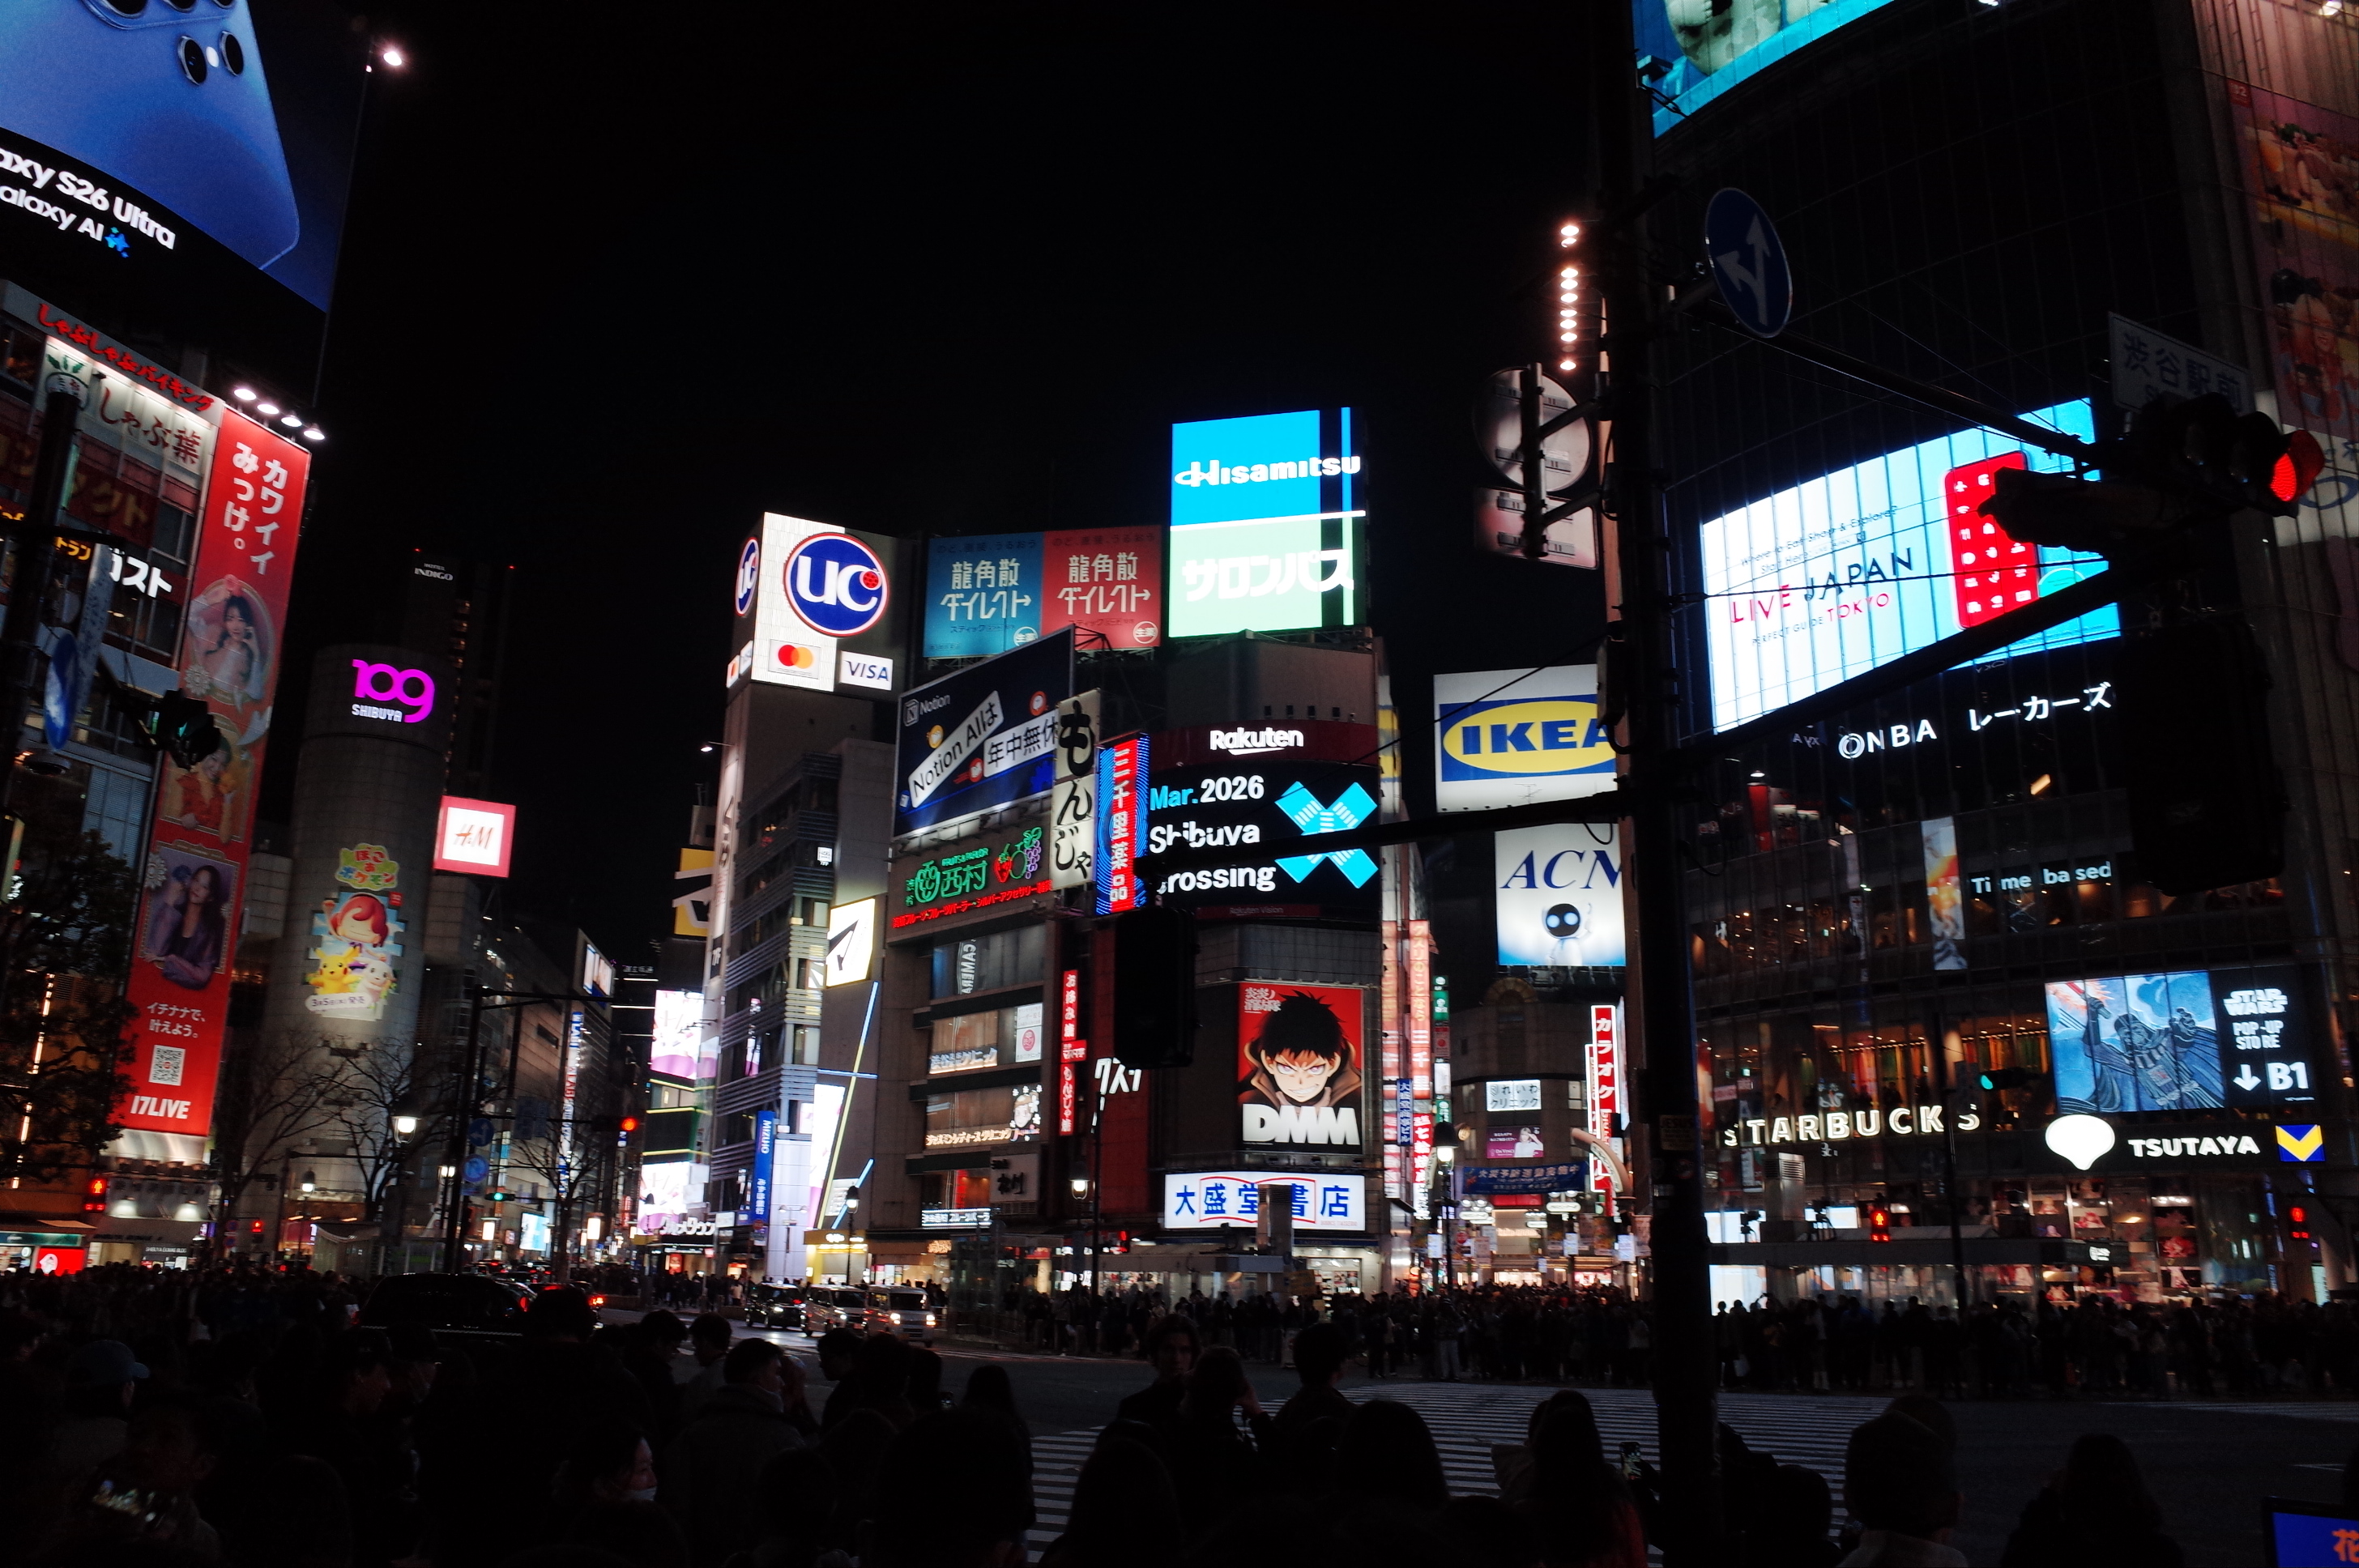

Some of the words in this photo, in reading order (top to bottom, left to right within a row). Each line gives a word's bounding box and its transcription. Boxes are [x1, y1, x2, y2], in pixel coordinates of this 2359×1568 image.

[55, 171, 110, 211] S26
[113, 196, 176, 250] Ultra
[77, 217, 105, 241] AI
[38, 303, 215, 411] しゃぶしゃぶバイキング
[99, 387, 203, 465] しゃぶ葉
[1175, 456, 1361, 487] Hisamitsu
[223, 441, 260, 550] みつけ。
[250, 458, 288, 576] カワイイ
[414, 568, 454, 582] INDIGO
[951, 557, 1021, 590] 龍角散
[1069, 552, 1138, 583] 龍角散
[1182, 548, 1354, 602] サロンパス
[1057, 584, 1151, 616] ダイレクト
[1730, 584, 1791, 624] LIVE
[1804, 548, 1913, 601] JAPAN
[940, 590, 1032, 621] ダイレクト
[1752, 627, 1790, 646] PERFECT
[1794, 617, 1824, 633] GUIDE
[1827, 593, 1889, 622] TOKYO
[844, 660, 889, 682] VISA
[352, 659, 435, 723] 109
[919, 693, 951, 715] Notion
[1969, 681, 2112, 731] レーカーズ
[352, 704, 403, 722] SHIBUYA
[1209, 726, 1304, 752] Rakuten
[1461, 718, 1610, 755] IKEA
[913, 739, 962, 798] Notion
[1054, 699, 1095, 879] もんじゃ
[454, 823, 495, 850] H&M
[1109, 748, 1131, 901] 三千里薬品
[339, 866, 396, 886] ポケモン
[1157, 866, 1277, 894] rossing
[2043, 861, 2111, 885] based
[2223, 999, 2288, 1016] WARS
[2229, 988, 2288, 1002] STAR
[147, 1002, 206, 1022] イチナナで、
[2233, 1020, 2284, 1036] POP-UP
[2236, 1034, 2280, 1050] STORE
[1595, 1017, 1615, 1100] カラオケ
[1501, 1084, 1538, 1095] れいわ
[2267, 1062, 2309, 1090] B1
[130, 1095, 191, 1119] 17LIVE
[1491, 1097, 1538, 1110] クリニック
[761, 1119, 772, 1154] MIZUHO
[1243, 1103, 1360, 1145] DMM
[1724, 1103, 1980, 1147] STARBUCKS
[2128, 1136, 2260, 1157] TSUTAYA
[1175, 1182, 1350, 1217] 大盛堂書店
